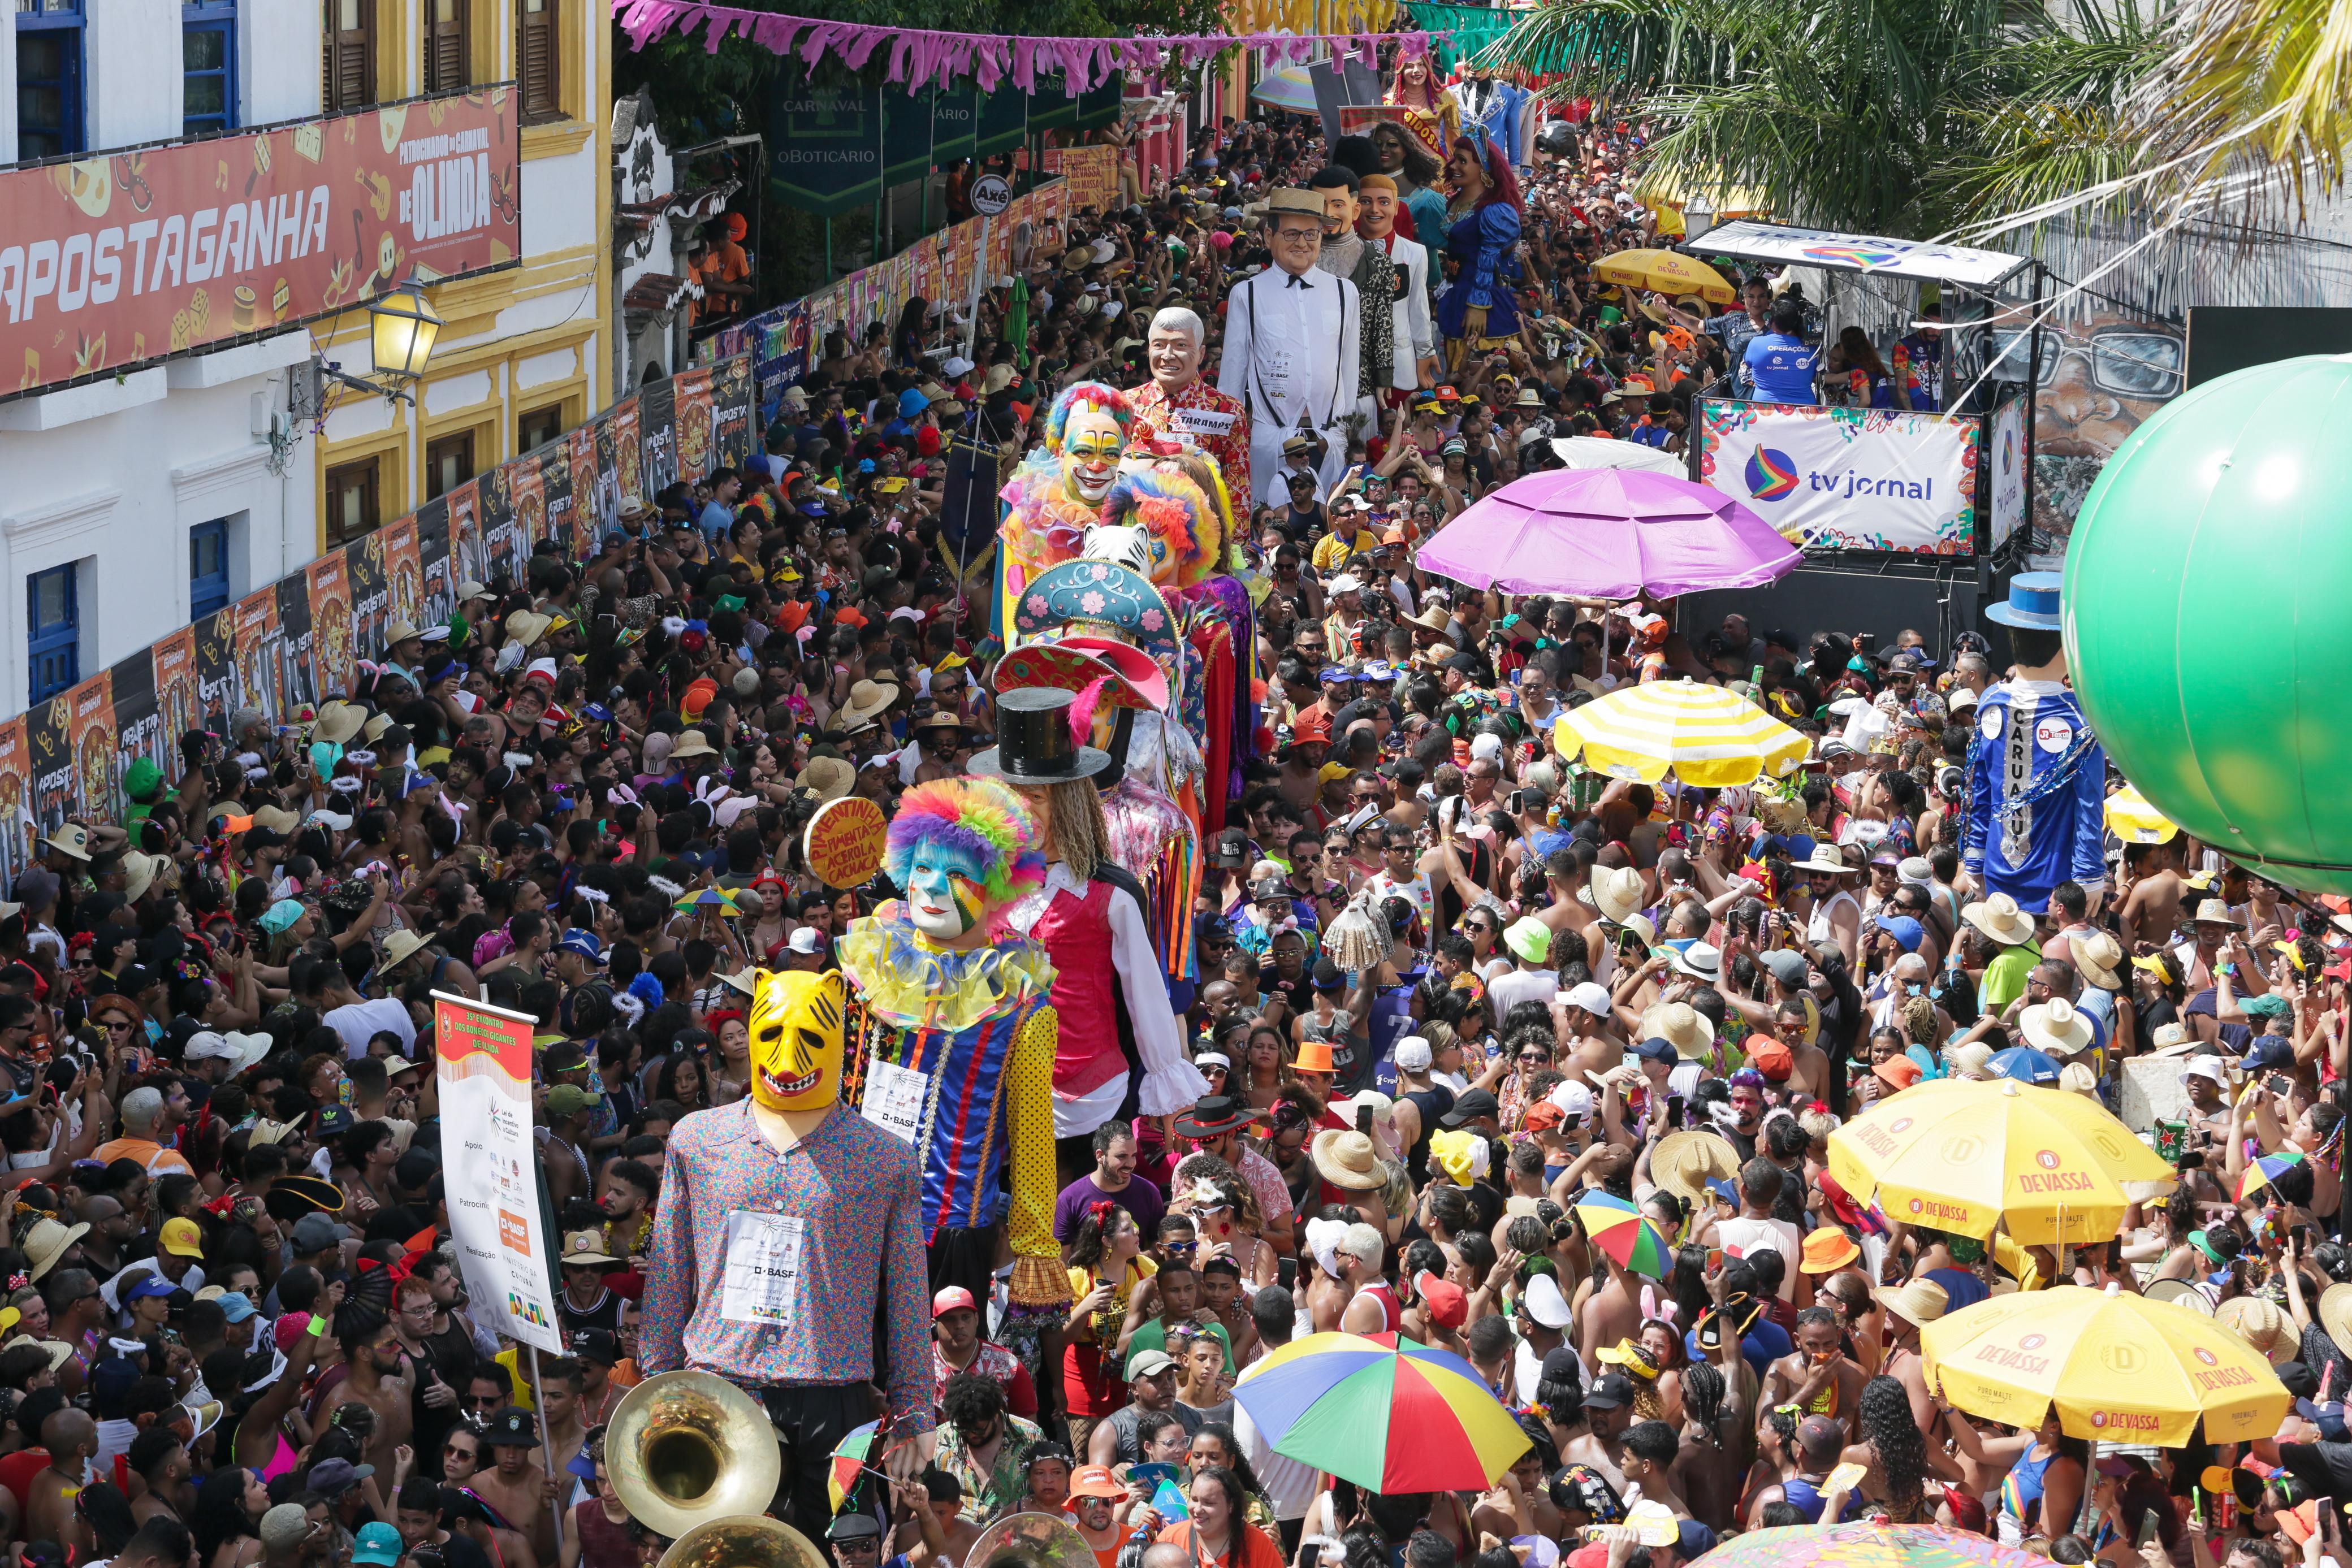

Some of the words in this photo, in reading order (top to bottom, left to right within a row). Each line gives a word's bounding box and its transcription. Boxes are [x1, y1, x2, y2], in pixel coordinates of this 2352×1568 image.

[783, 99, 868, 112] CARNAVAL
[399, 134, 449, 165] PATROCINADOR
[449, 137, 456, 151] DO
[456, 127, 489, 154] CARNAVAL
[1082, 179, 1100, 189] MASSA
[399, 189, 412, 224] DE
[412, 152, 491, 242] OLINDA
[976, 185, 1008, 203] Axé
[1617, 272, 1633, 281] DEVASSA
[1658, 266, 1690, 277] DEVASSA
[1767, 345, 1810, 353] OPERAÇÕES
[1181, 416, 1231, 430] TARAMPS
[1809, 471, 1840, 492] tv
[1844, 470, 1932, 500] jornal
[454, 490, 473, 505] APOSTA
[456, 500, 473, 517] GANHA
[391, 523, 410, 541] APOSTA
[392, 533, 410, 551] GANHA
[316, 559, 338, 578] APOSTA
[317, 570, 338, 590] GANHA
[243, 596, 267, 616] APOSTA
[163, 649, 185, 669] GANHA
[77, 682, 102, 705] APOSTA
[79, 694, 102, 717] GANHA
[811, 800, 886, 861] PIMENTINHA
[827, 825, 871, 853] PIMENTA
[827, 841, 877, 871] ACEROLA
[455, 1021, 465, 1033] DOS
[490, 1032, 516, 1046] GIGANTES
[473, 1039, 482, 1048] DE
[502, 1118, 519, 1129] Incentivo
[894, 1116, 916, 1128] BASF
[506, 1127, 519, 1138] Cultura
[1855, 1123, 1898, 1159] DEVASSA
[465, 1140, 483, 1150] Apoio
[2019, 1172, 2095, 1193] DEVASSA
[460, 1198, 490, 1210] Patrocínio
[1926, 1201, 1968, 1223] DEVASSA
[509, 1222, 525, 1237] BASF
[466, 1245, 496, 1260] Realização
[767, 1268, 794, 1278] BASF
[466, 1279, 487, 1309] 20
[485, 1305, 507, 1329] 24
[509, 1292, 550, 1329] BRASIL
[1975, 1344, 2051, 1375] DEVASSA
[2194, 1366, 2258, 1391] DEVASSA
[1978, 1386, 1992, 1396] PURO
[1994, 1389, 2013, 1401] MALTE
[2110, 1413, 2160, 1431] DEVASSA
